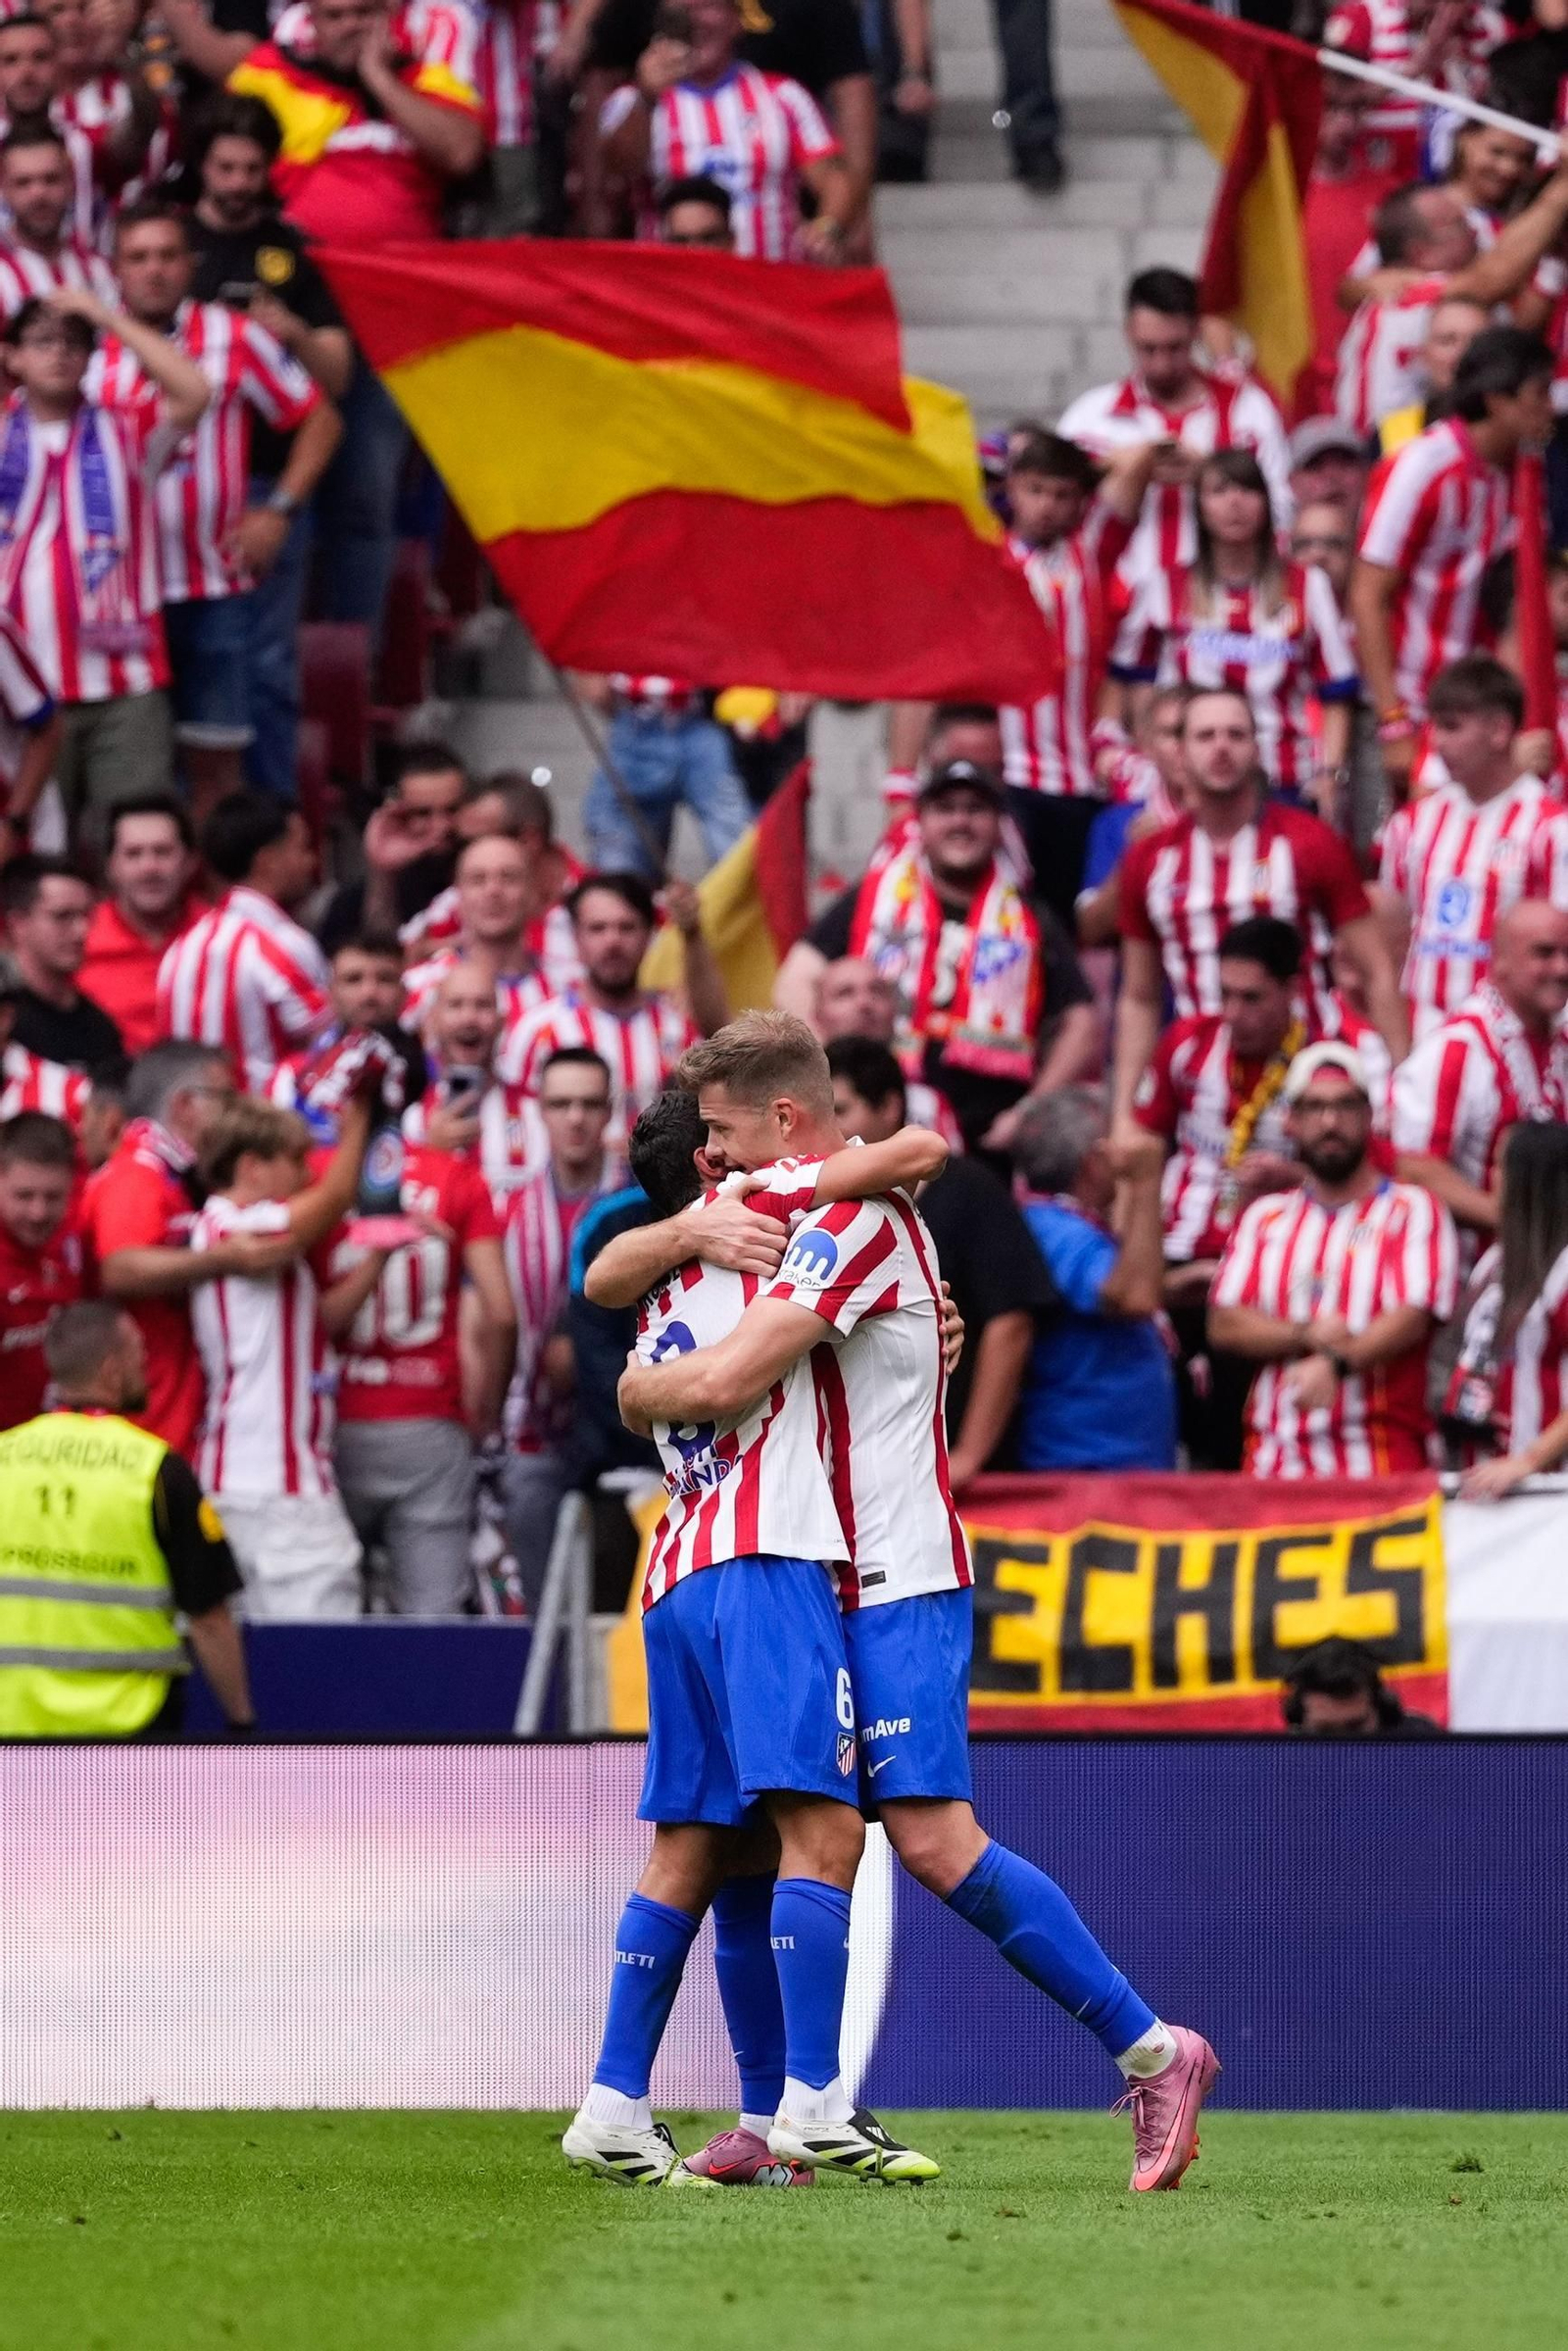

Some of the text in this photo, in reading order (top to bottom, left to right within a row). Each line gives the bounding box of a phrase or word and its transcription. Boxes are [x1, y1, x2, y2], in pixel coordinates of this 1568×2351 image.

[0, 1434, 144, 1470] EGURIDAD
[971, 1515, 1429, 1693] ECHES
[836, 1667, 855, 1730] 6
[861, 1717, 911, 1742] mAve
[769, 1935, 795, 1949] LETI
[615, 1950, 655, 1970] TLETI
